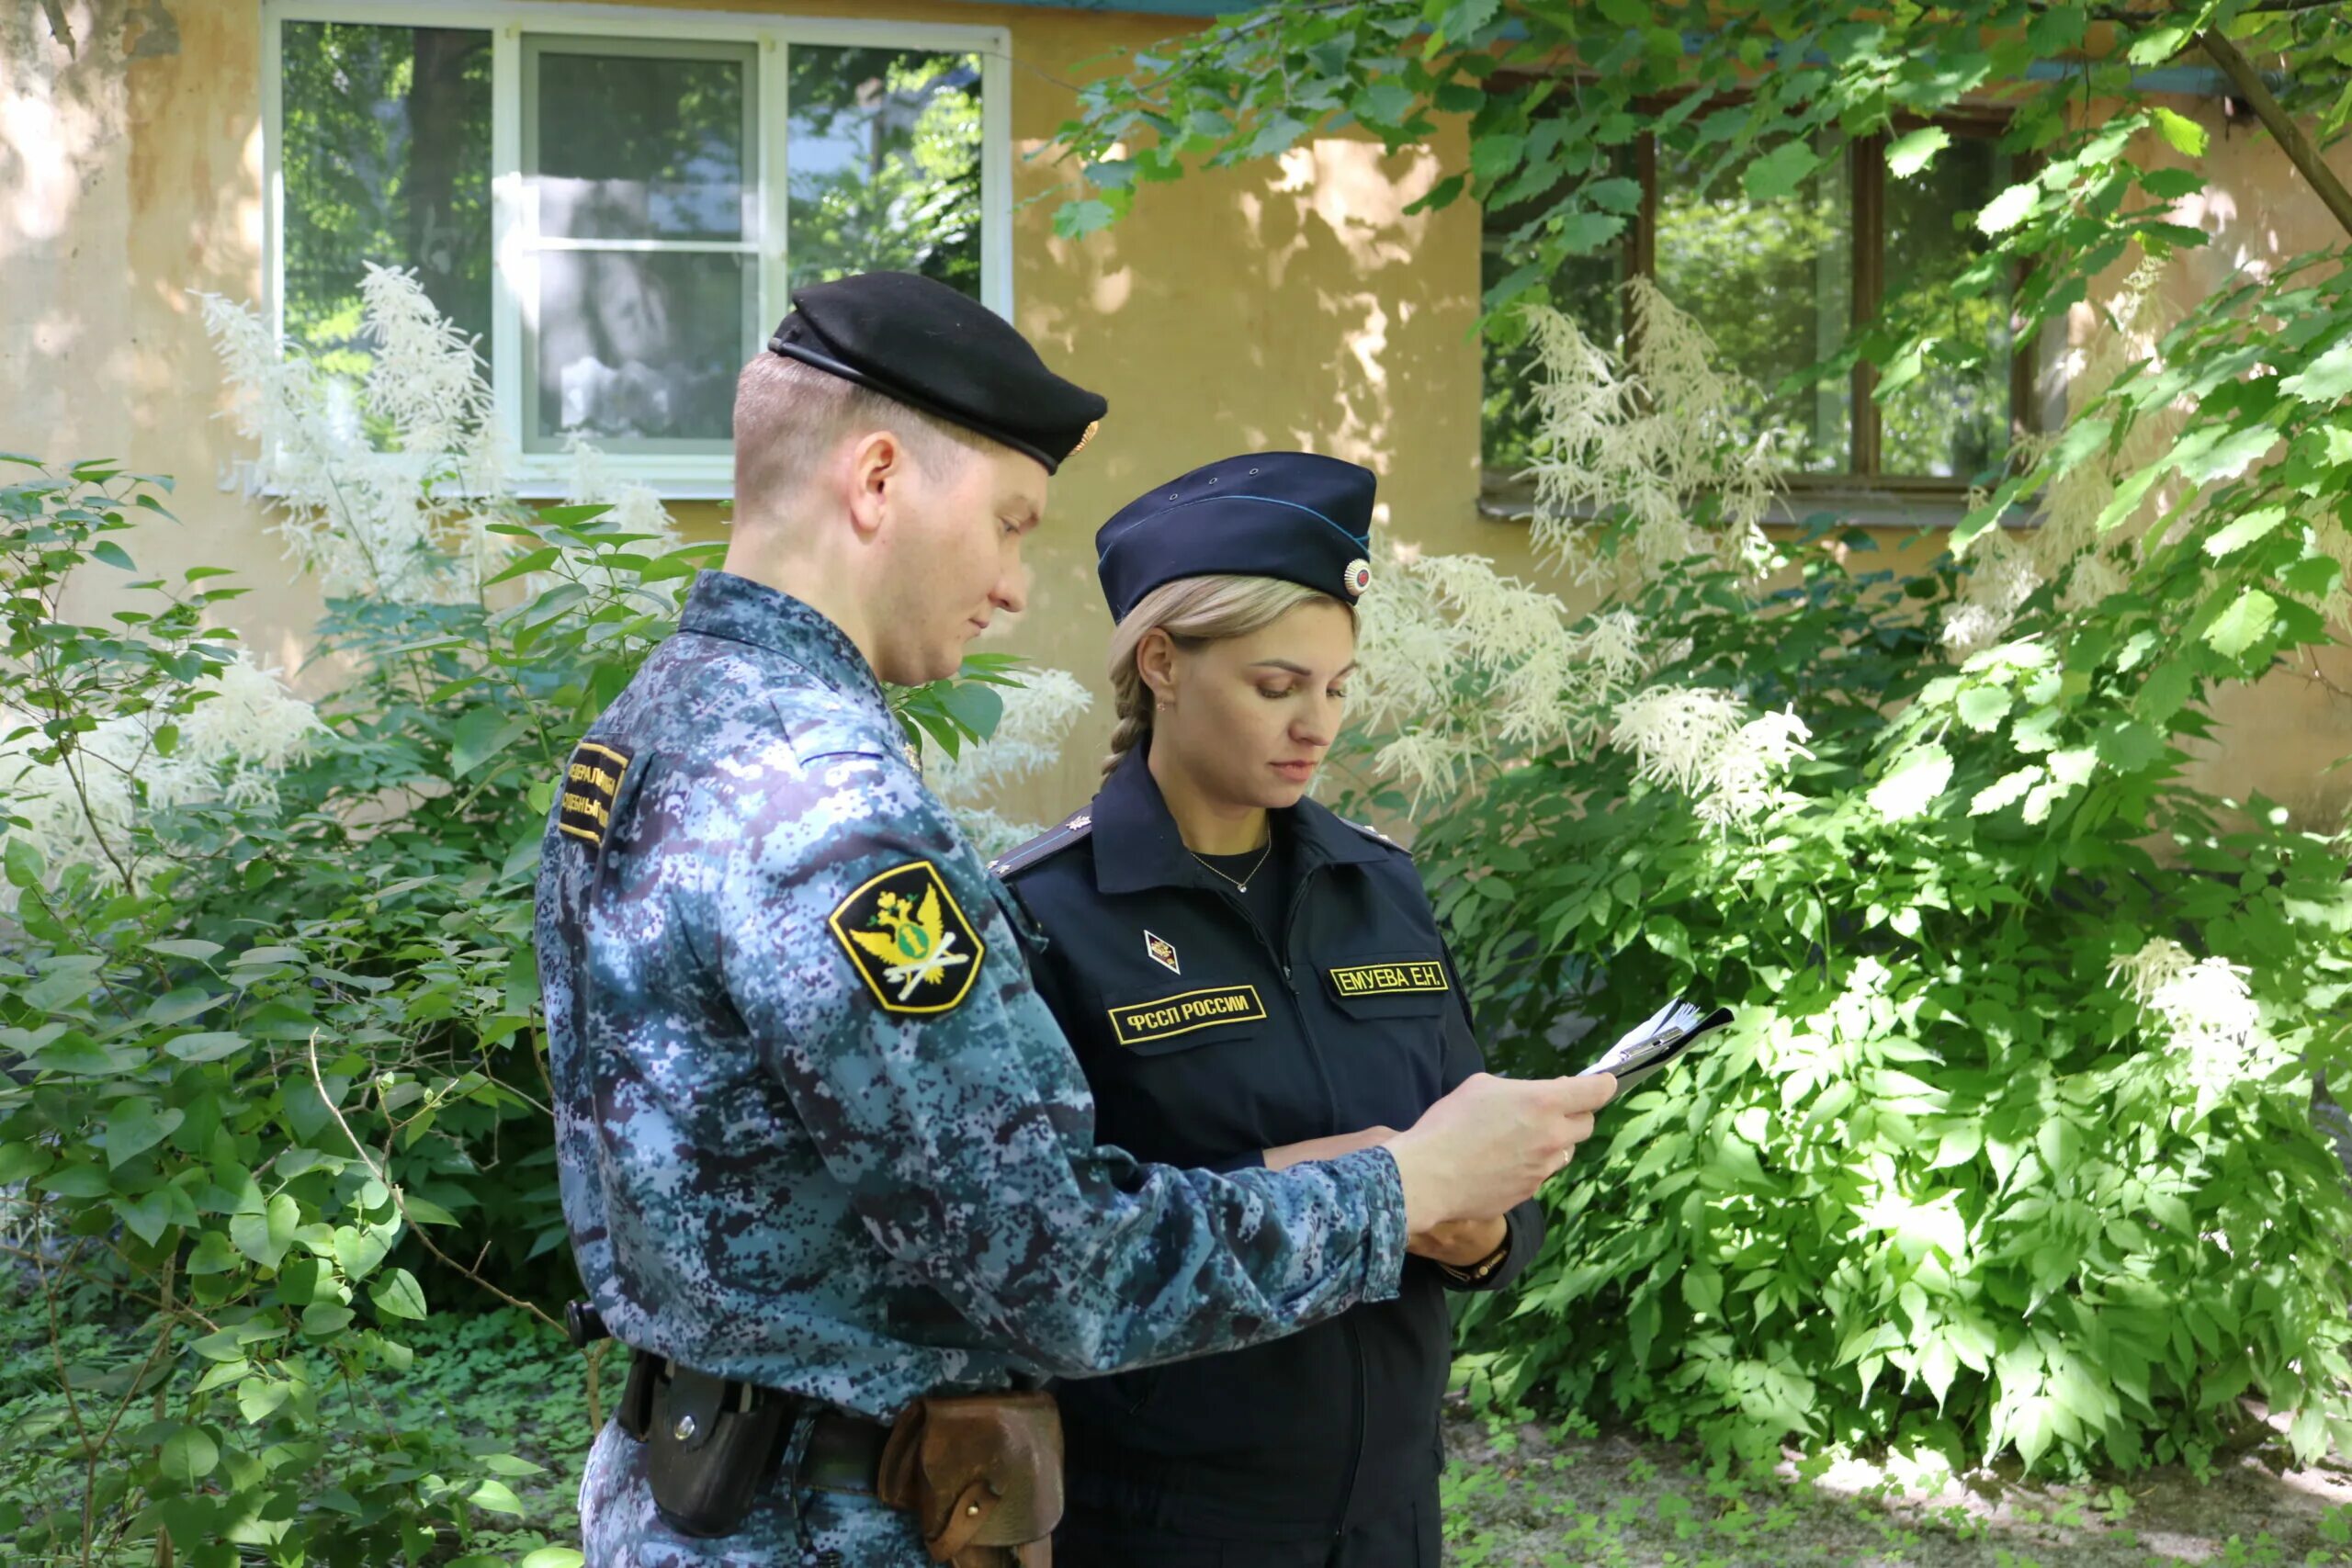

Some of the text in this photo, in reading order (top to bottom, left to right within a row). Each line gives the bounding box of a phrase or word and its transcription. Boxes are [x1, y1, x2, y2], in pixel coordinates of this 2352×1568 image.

[1339, 965, 1441, 991] ЕМУЕВА Е.Н.
[1126, 995, 1250, 1032] ФССП РОССИИ
